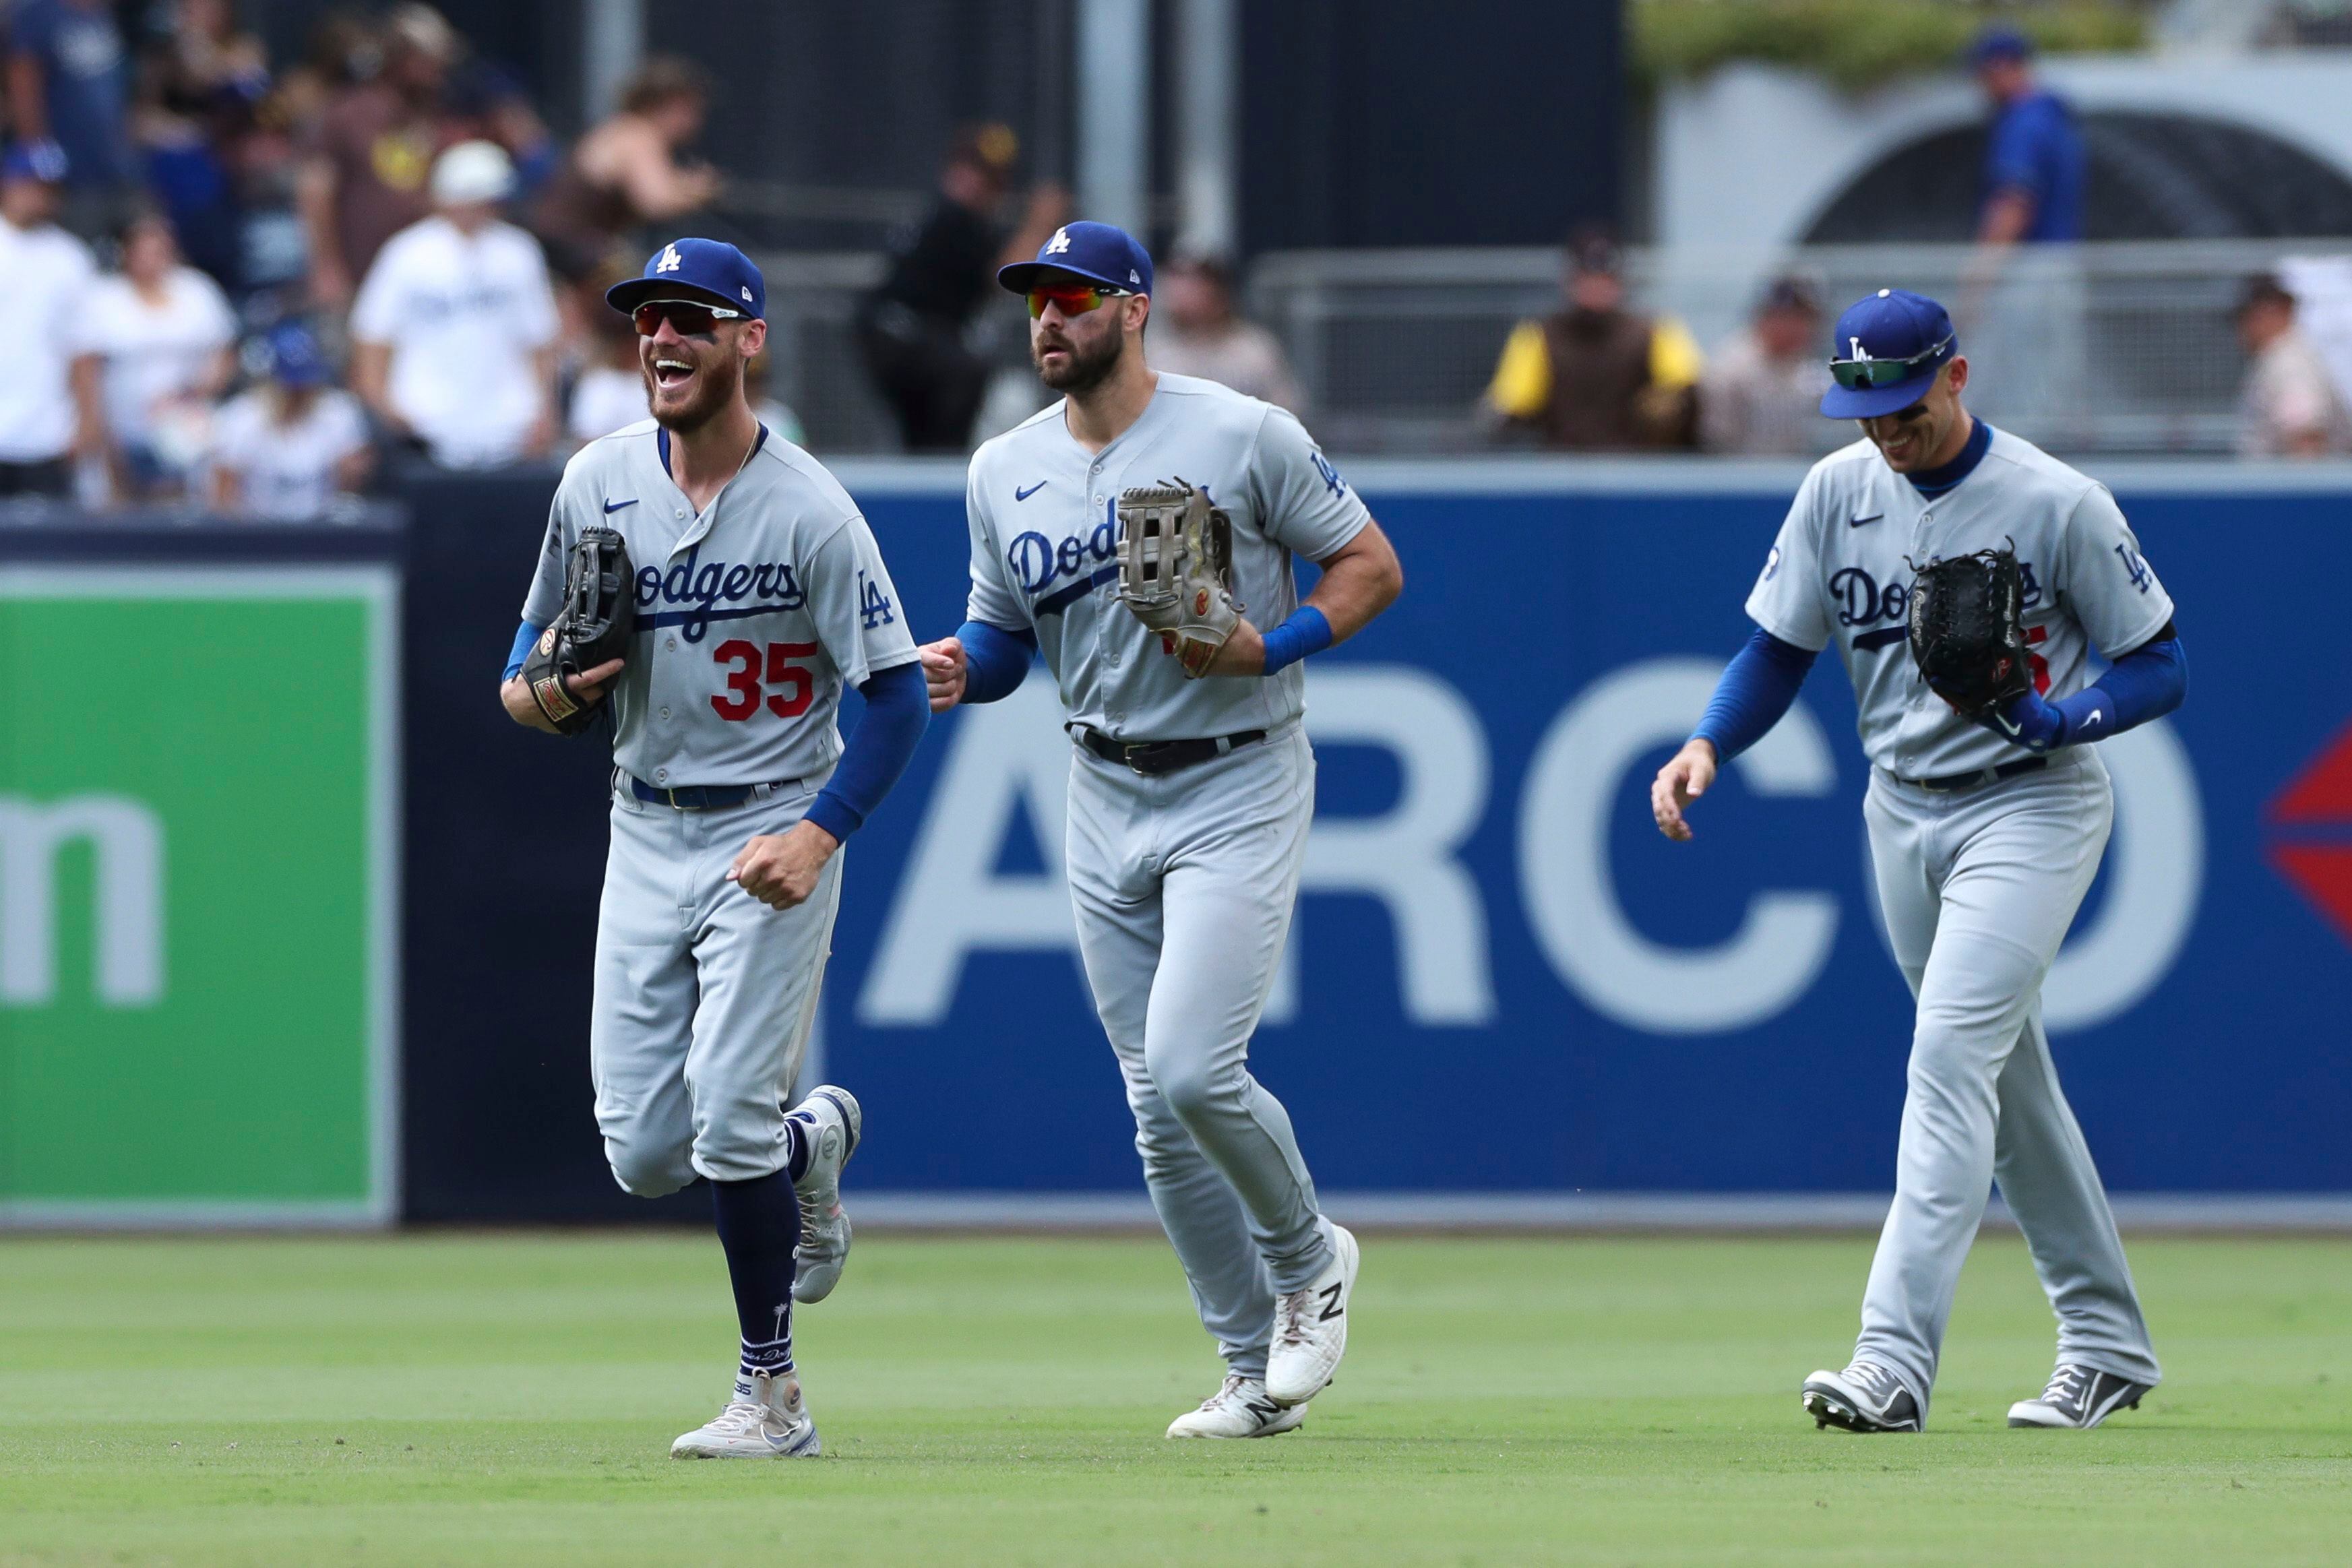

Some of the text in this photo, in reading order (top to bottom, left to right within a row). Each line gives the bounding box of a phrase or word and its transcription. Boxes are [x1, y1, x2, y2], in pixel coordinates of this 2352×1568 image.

[656, 243, 682, 274] LA
[1046, 226, 1071, 255] LA
[633, 542, 807, 644] odgers
[2114, 544, 2153, 594] LA
[858, 569, 894, 630] LA
[710, 639, 818, 722] 35
